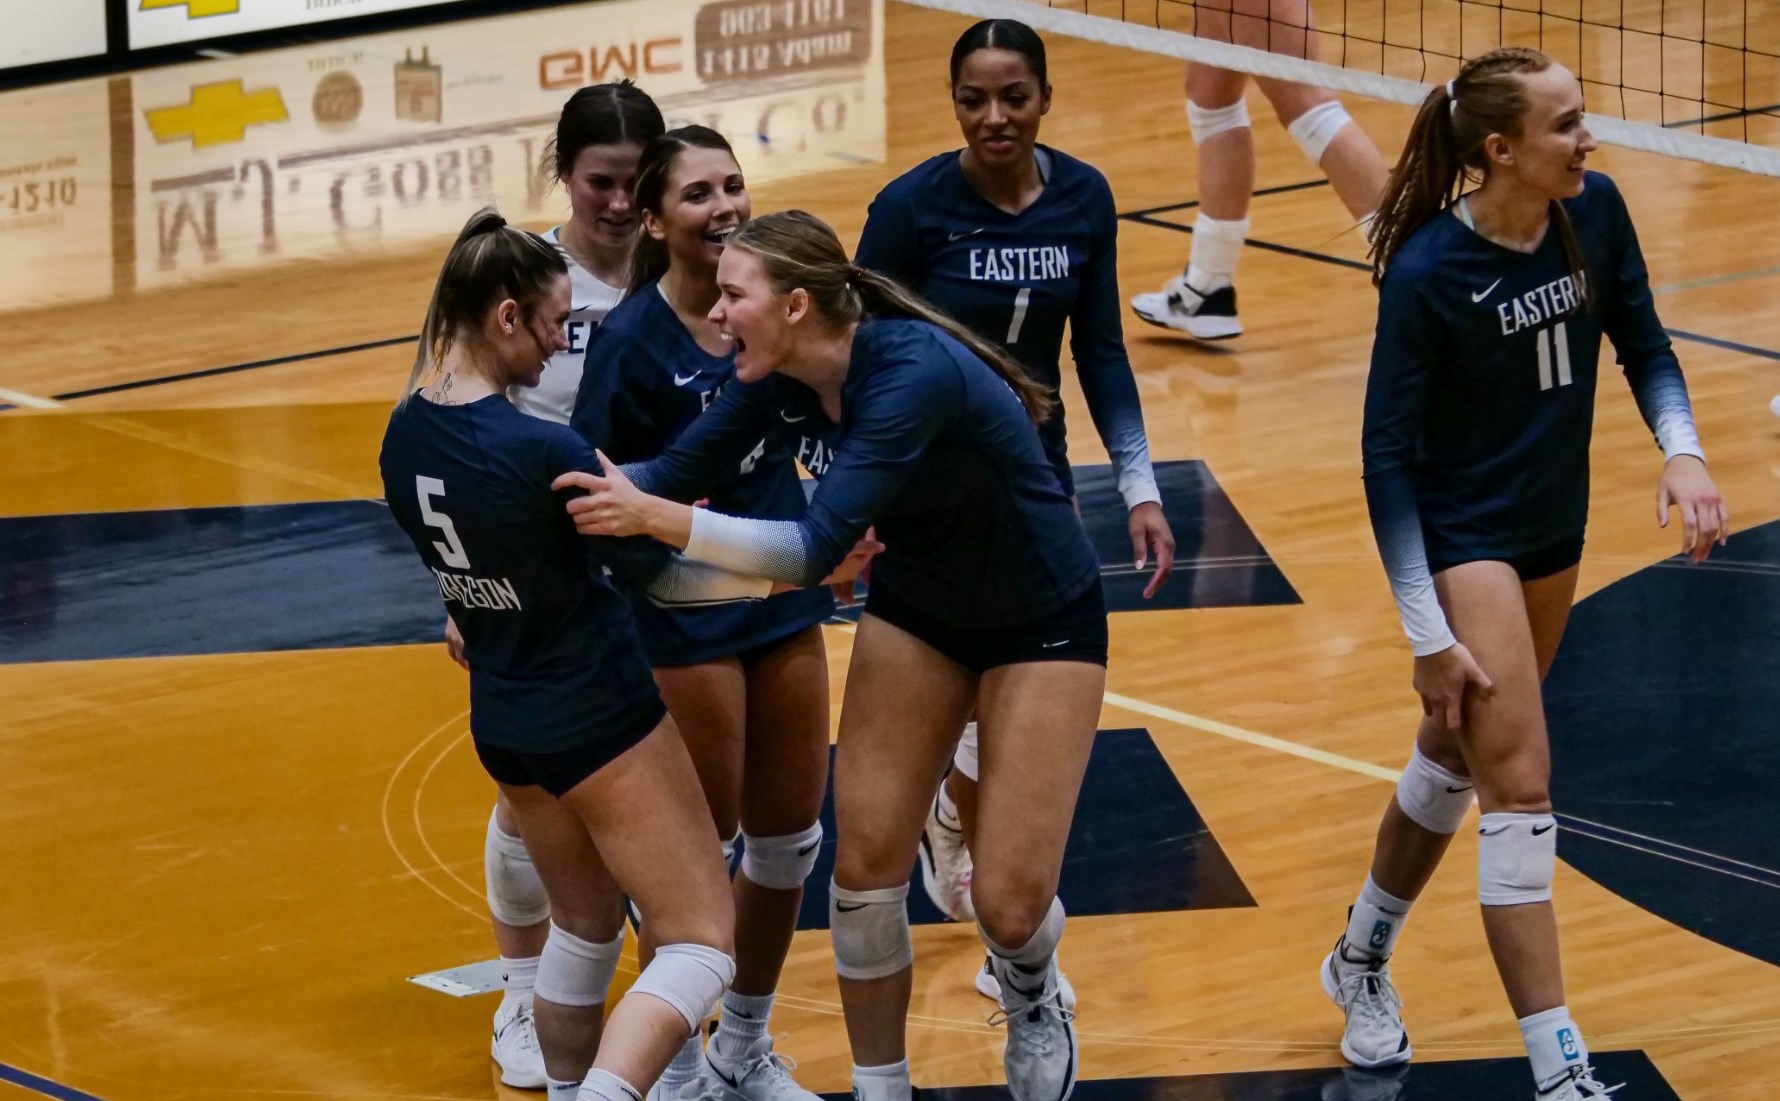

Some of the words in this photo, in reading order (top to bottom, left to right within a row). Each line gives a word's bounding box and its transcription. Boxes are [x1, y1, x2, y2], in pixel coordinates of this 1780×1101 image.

[969, 245, 1069, 281] EASTERN
[1006, 287, 1032, 344] 1
[1497, 269, 1587, 336] EASTERN
[1536, 321, 1573, 391] 11
[415, 474, 471, 570] 5
